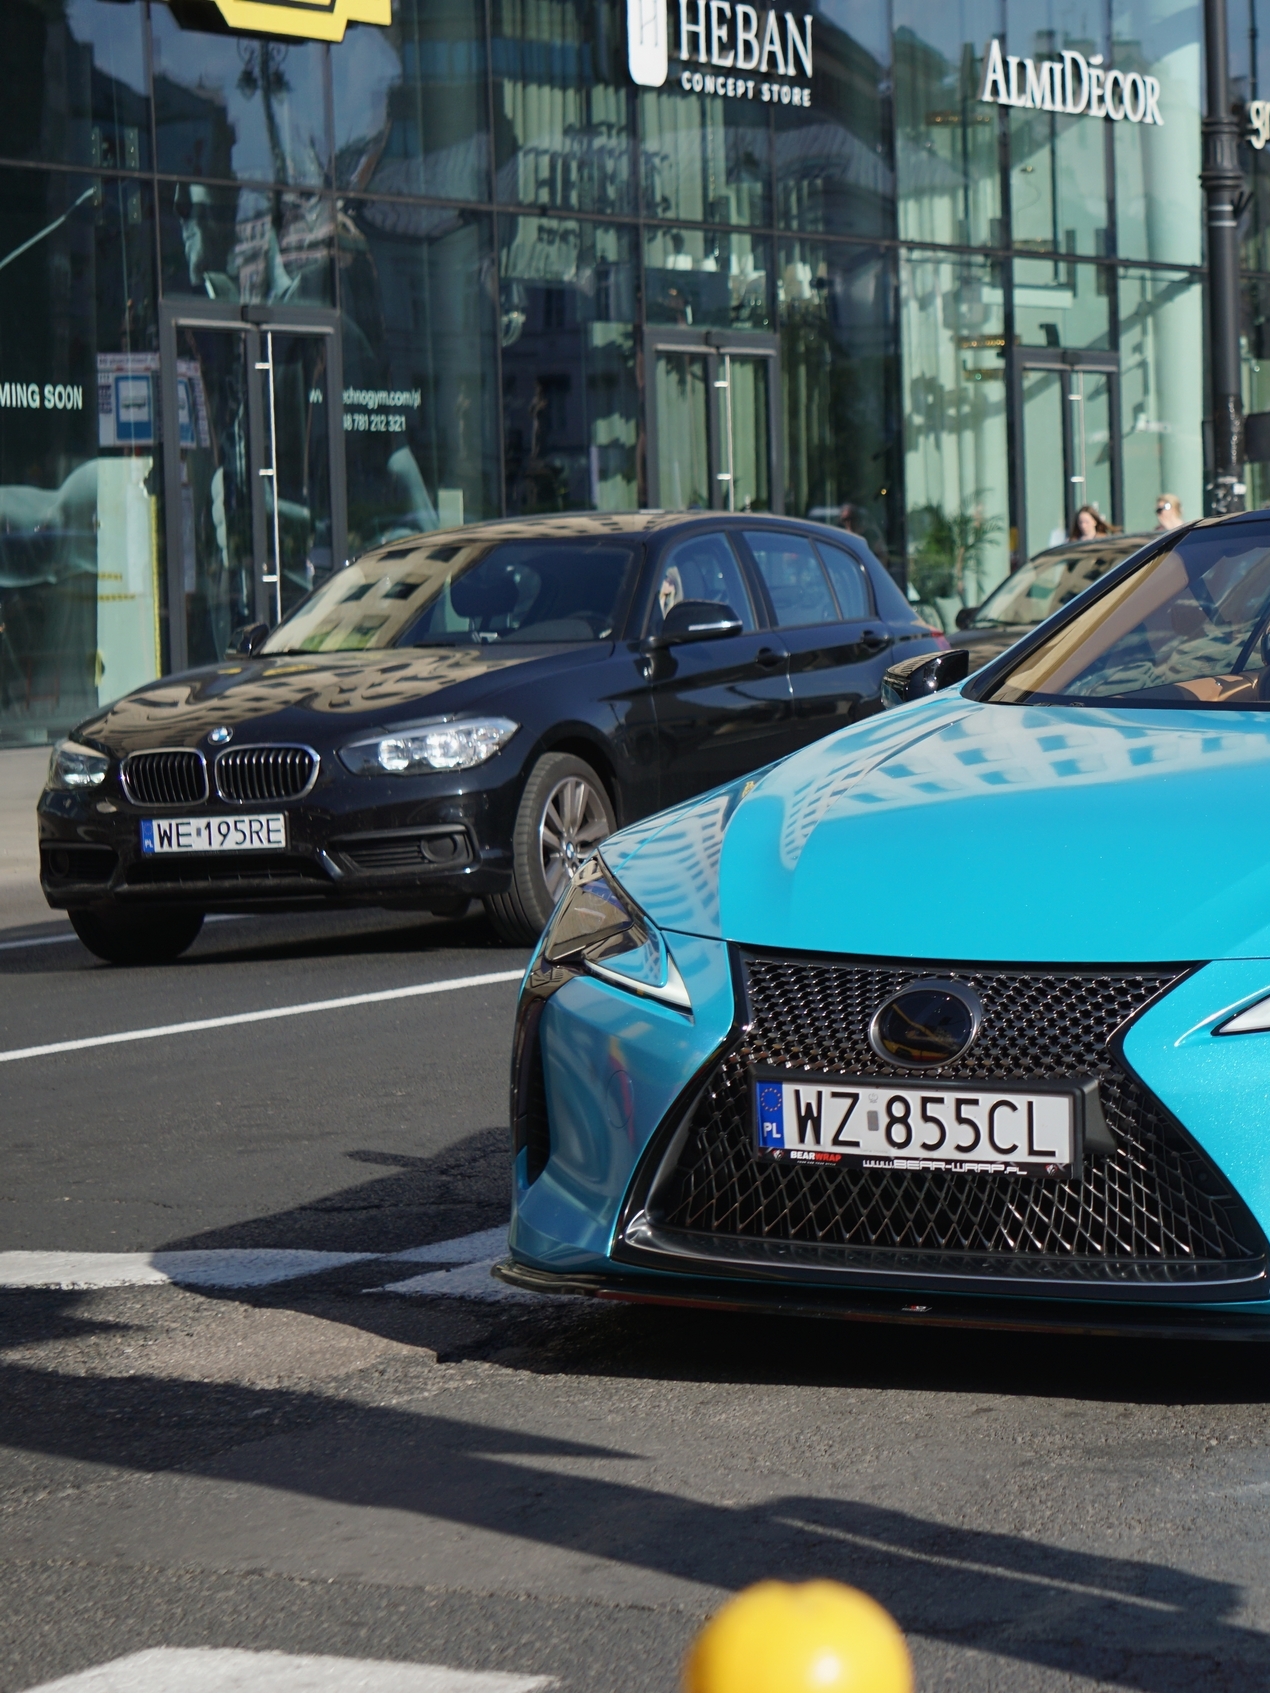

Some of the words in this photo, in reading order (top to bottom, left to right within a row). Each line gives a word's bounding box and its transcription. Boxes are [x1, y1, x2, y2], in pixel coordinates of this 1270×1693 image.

[679, 0, 813, 78] HEBAN
[681, 71, 755, 99] CONCEPT
[761, 83, 812, 107] STORE
[44, 383, 82, 410] SOON
[353, 413, 368, 431] 781
[370, 414, 387, 432] 212
[388, 414, 406, 432] 321
[157, 822, 192, 848] WE
[204, 818, 283, 847] 195RE
[763, 1122, 782, 1139] PL
[794, 1088, 860, 1148] WZ
[885, 1094, 1056, 1157] 855CL
